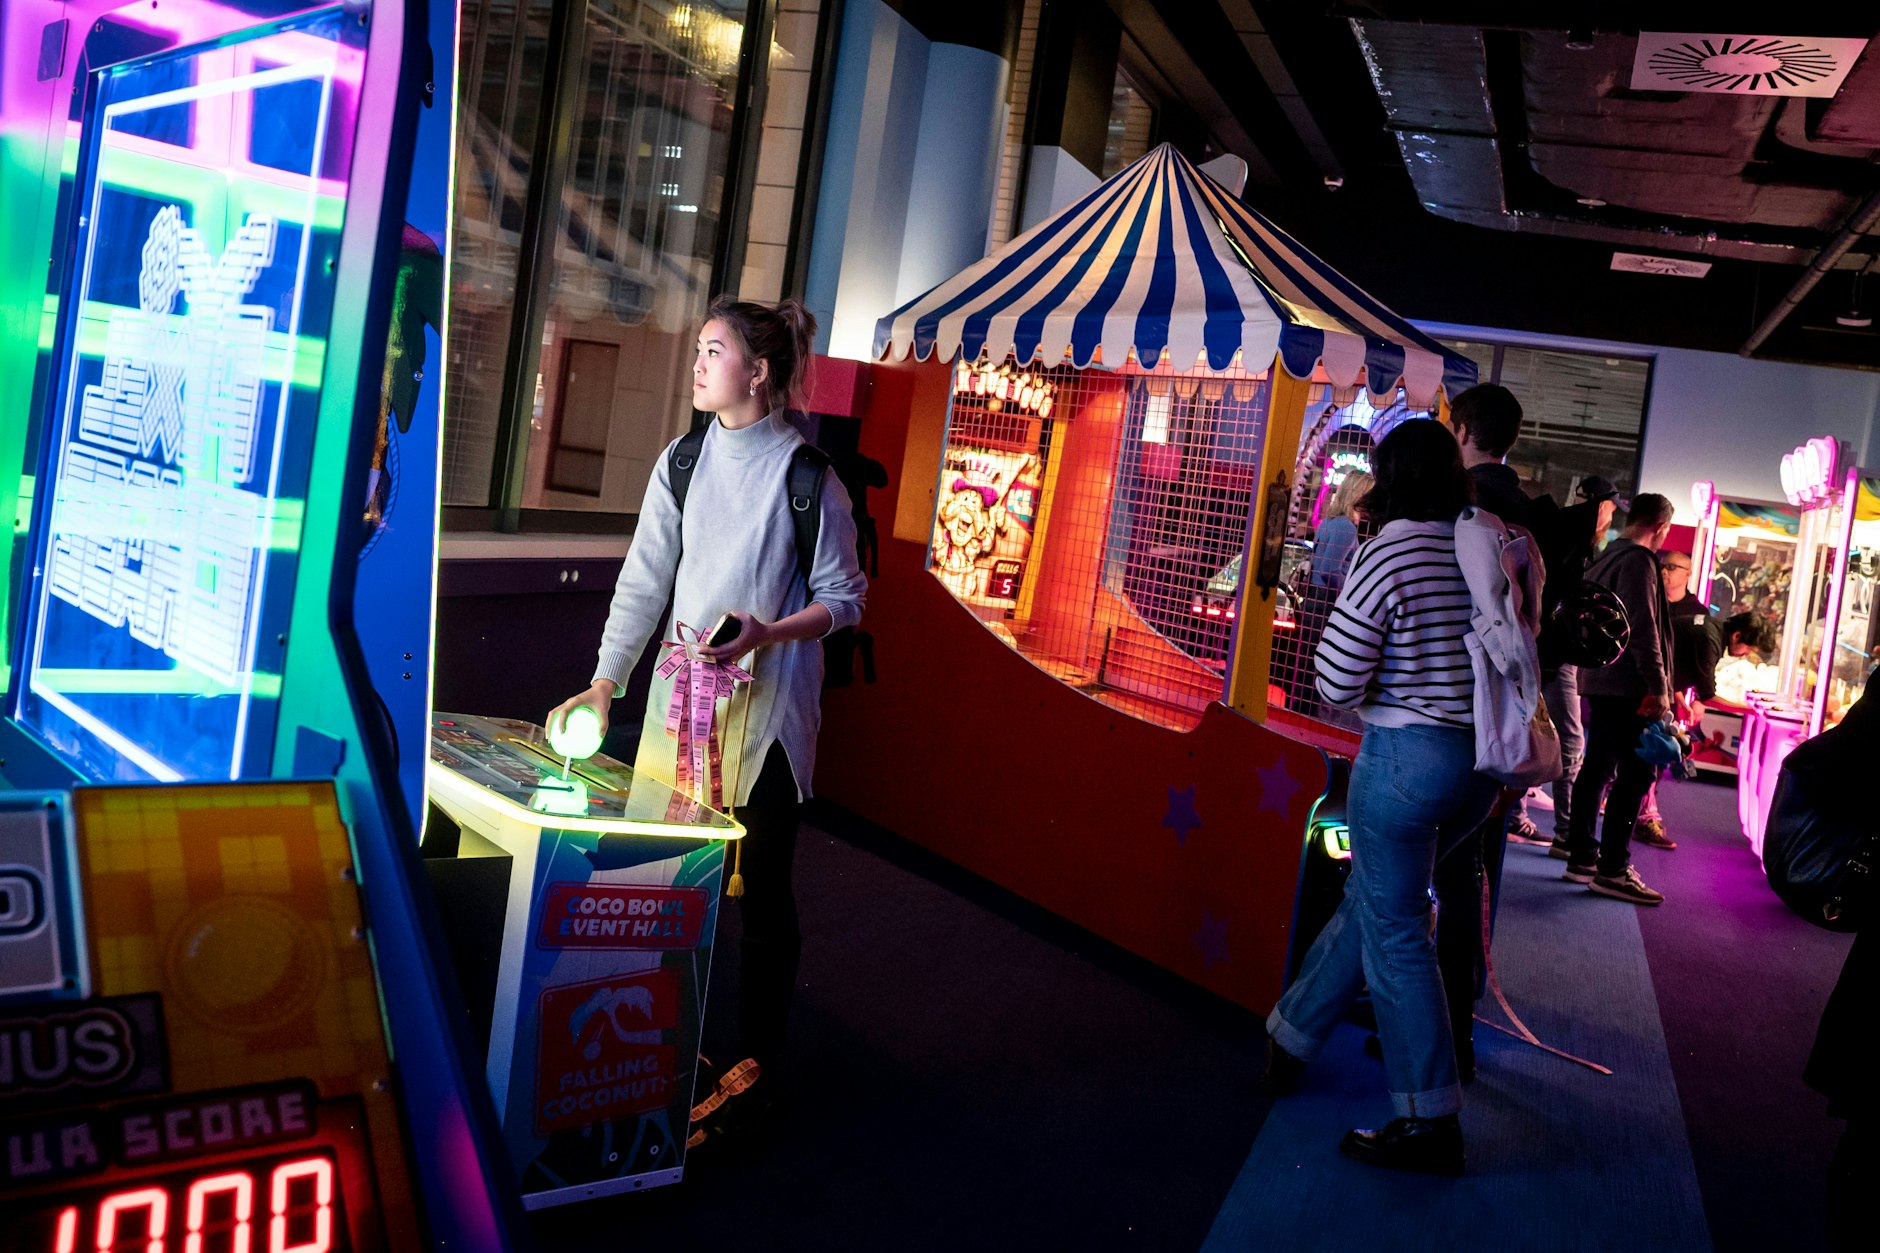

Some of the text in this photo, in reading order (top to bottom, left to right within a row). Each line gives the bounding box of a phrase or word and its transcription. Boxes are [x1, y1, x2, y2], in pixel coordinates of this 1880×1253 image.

[1001, 578, 1012, 594] 5
[567, 897, 687, 917] COCO BOWL
[559, 918, 687, 938] EVENT HALL
[559, 1054, 659, 1094] FALLING
[123, 1090, 307, 1160] SCORE
